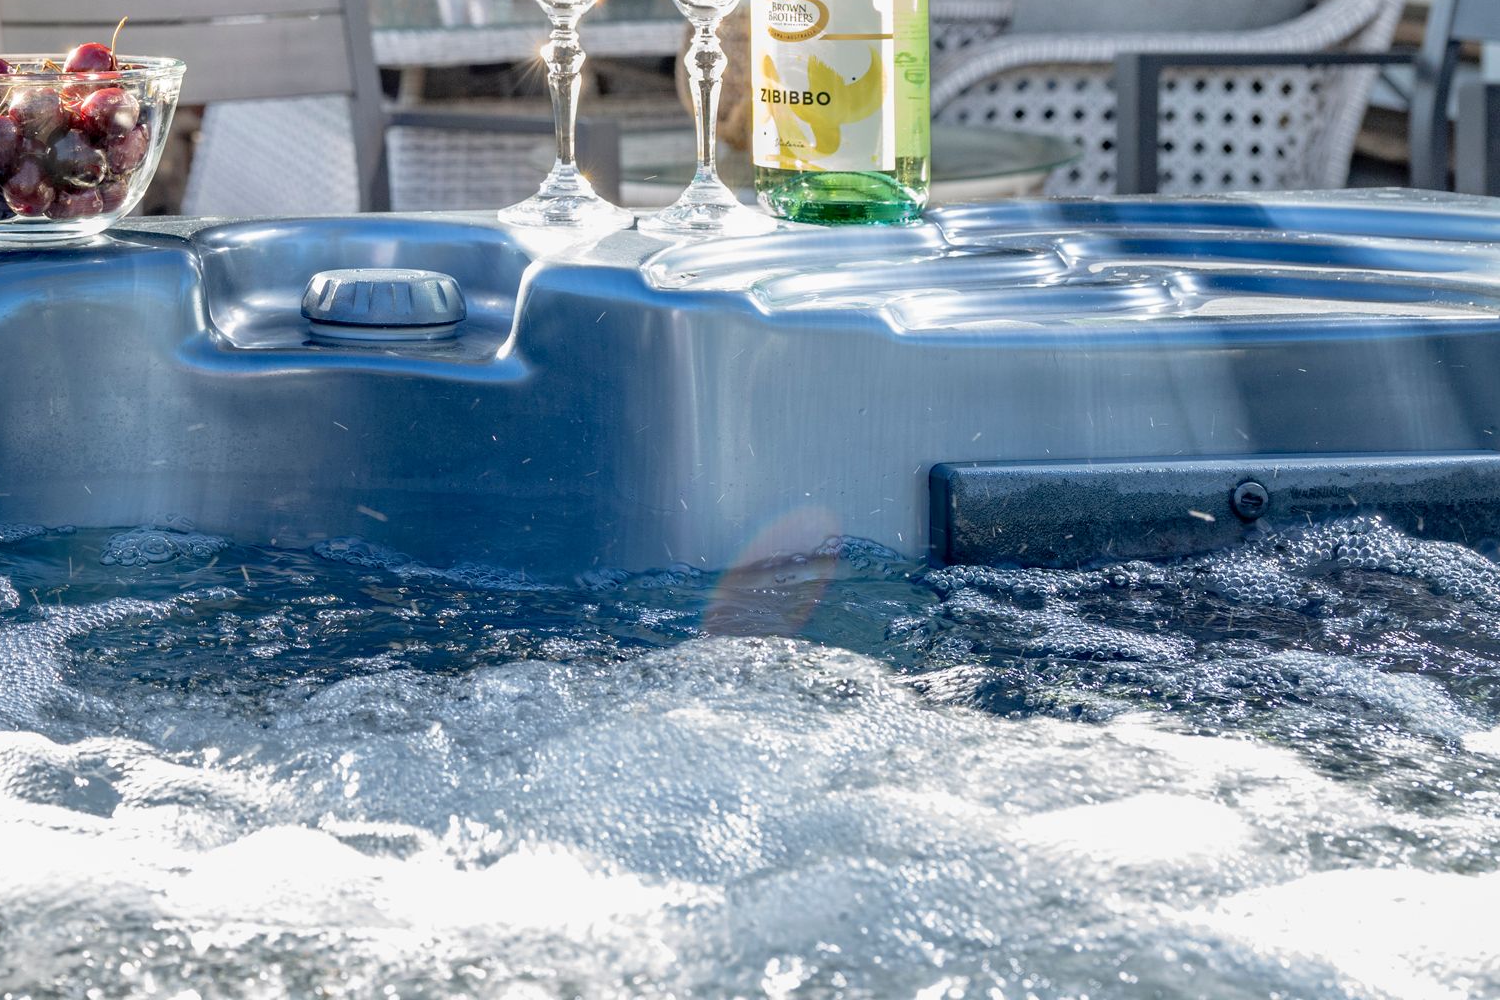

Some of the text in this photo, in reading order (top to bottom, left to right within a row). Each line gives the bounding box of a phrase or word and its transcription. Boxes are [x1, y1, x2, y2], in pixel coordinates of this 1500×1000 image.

[771, 2, 807, 13] BROWN
[768, 10, 813, 23] BROTHERS
[761, 88, 831, 106] ZIBIBBO
[1289, 486, 1345, 499] WARNING
